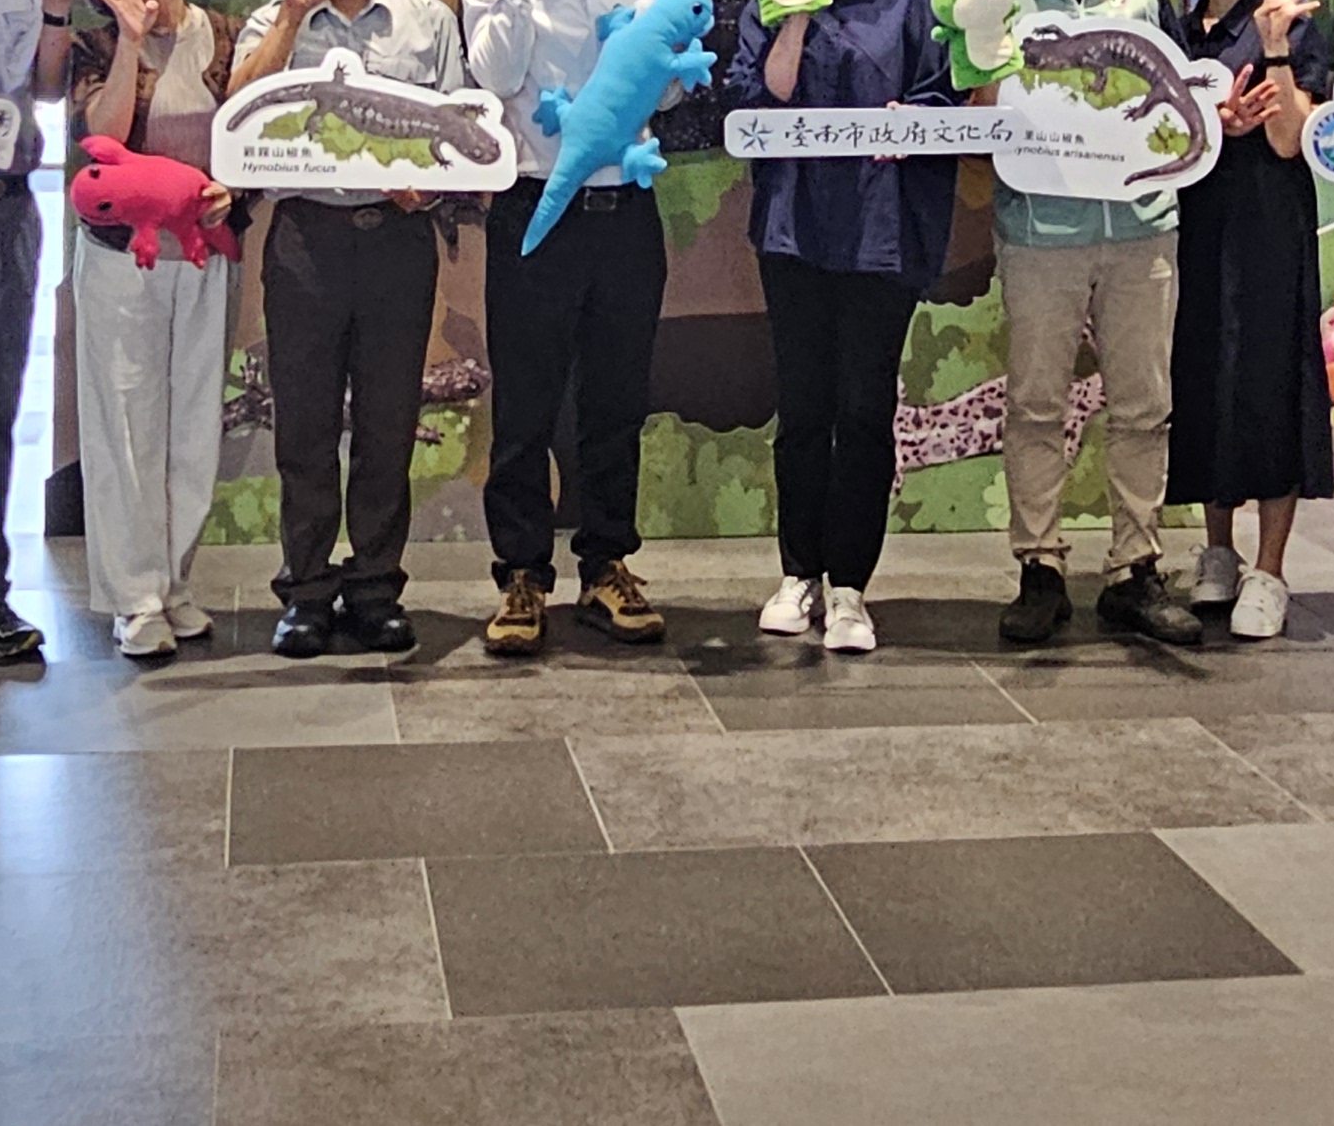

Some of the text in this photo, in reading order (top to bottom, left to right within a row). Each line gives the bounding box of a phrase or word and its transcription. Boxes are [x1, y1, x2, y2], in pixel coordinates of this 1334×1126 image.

[784, 117, 1013, 149] 臺南市政府文化局
[1024, 130, 1085, 145] 里山山椒魚
[1014, 145, 1061, 157] ynobius
[242, 162, 337, 174] Hynobius fucus
